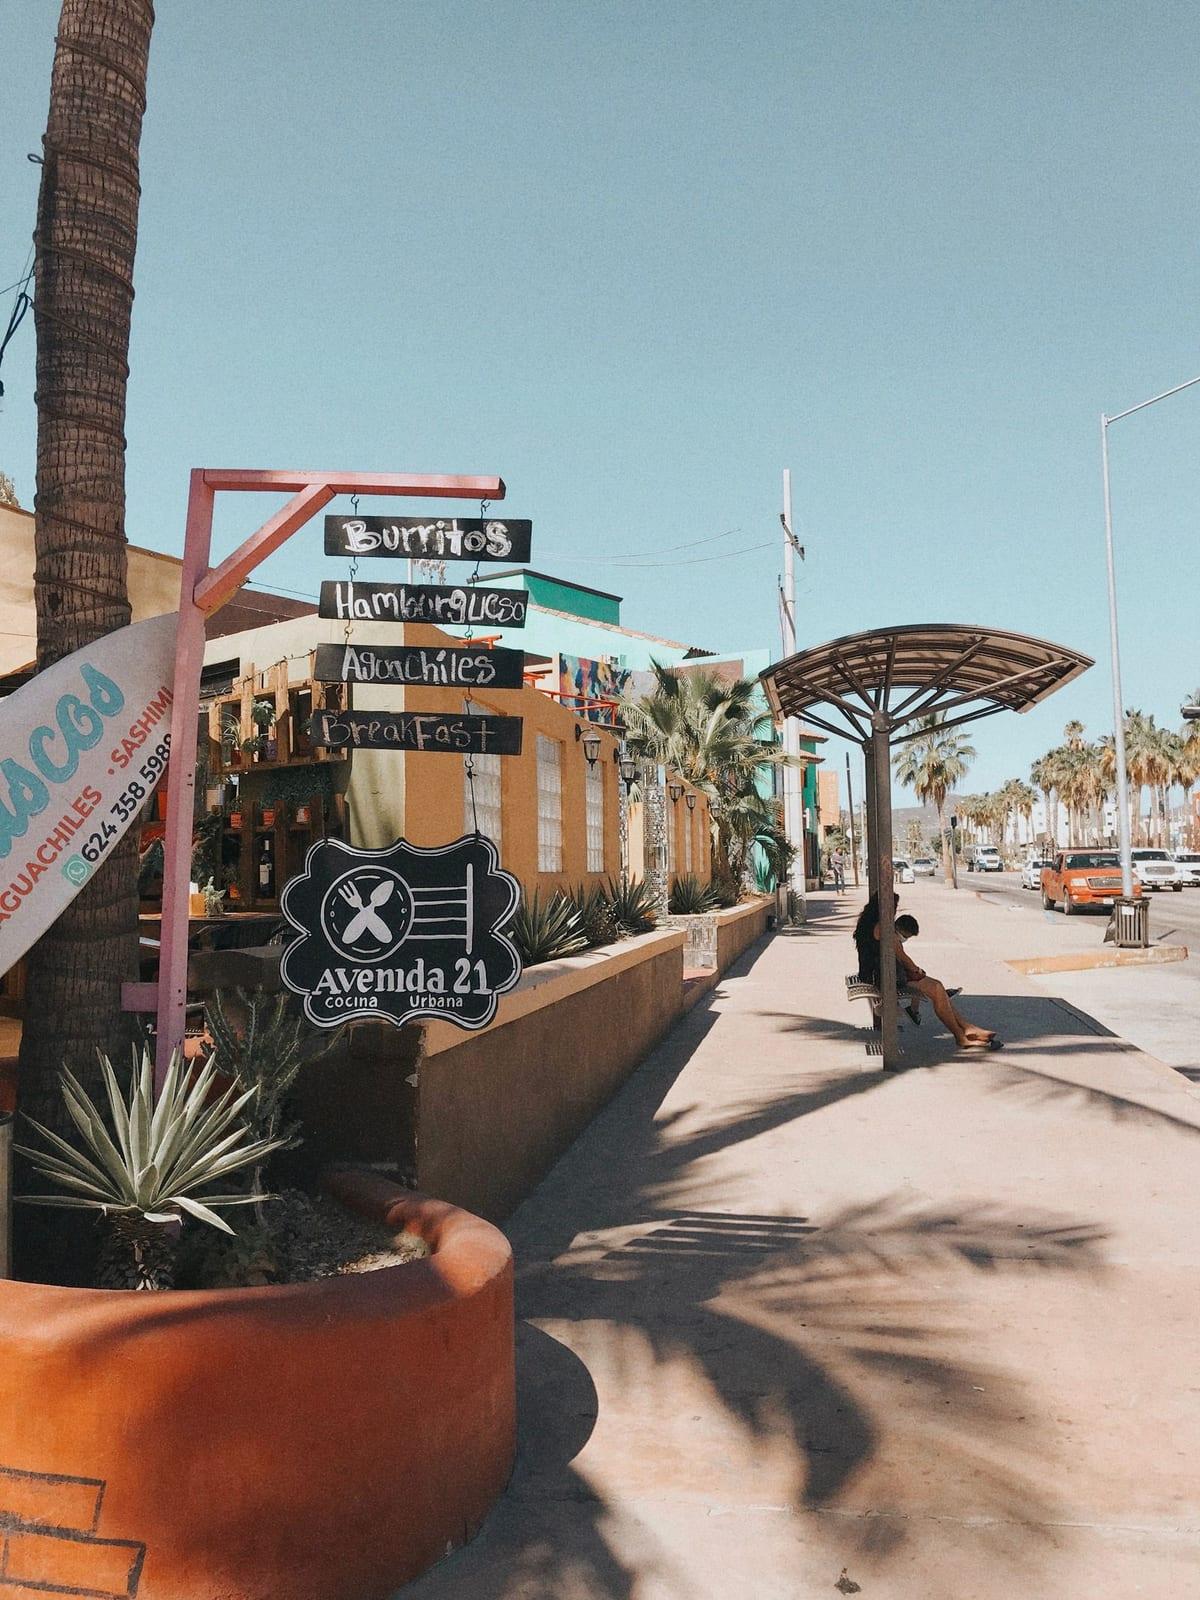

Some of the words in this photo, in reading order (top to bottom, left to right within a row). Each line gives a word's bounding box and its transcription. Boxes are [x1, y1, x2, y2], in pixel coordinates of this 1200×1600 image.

[81, 821, 118, 862] 624
[110, 782, 146, 822] 358
[453, 957, 493, 995] 21
